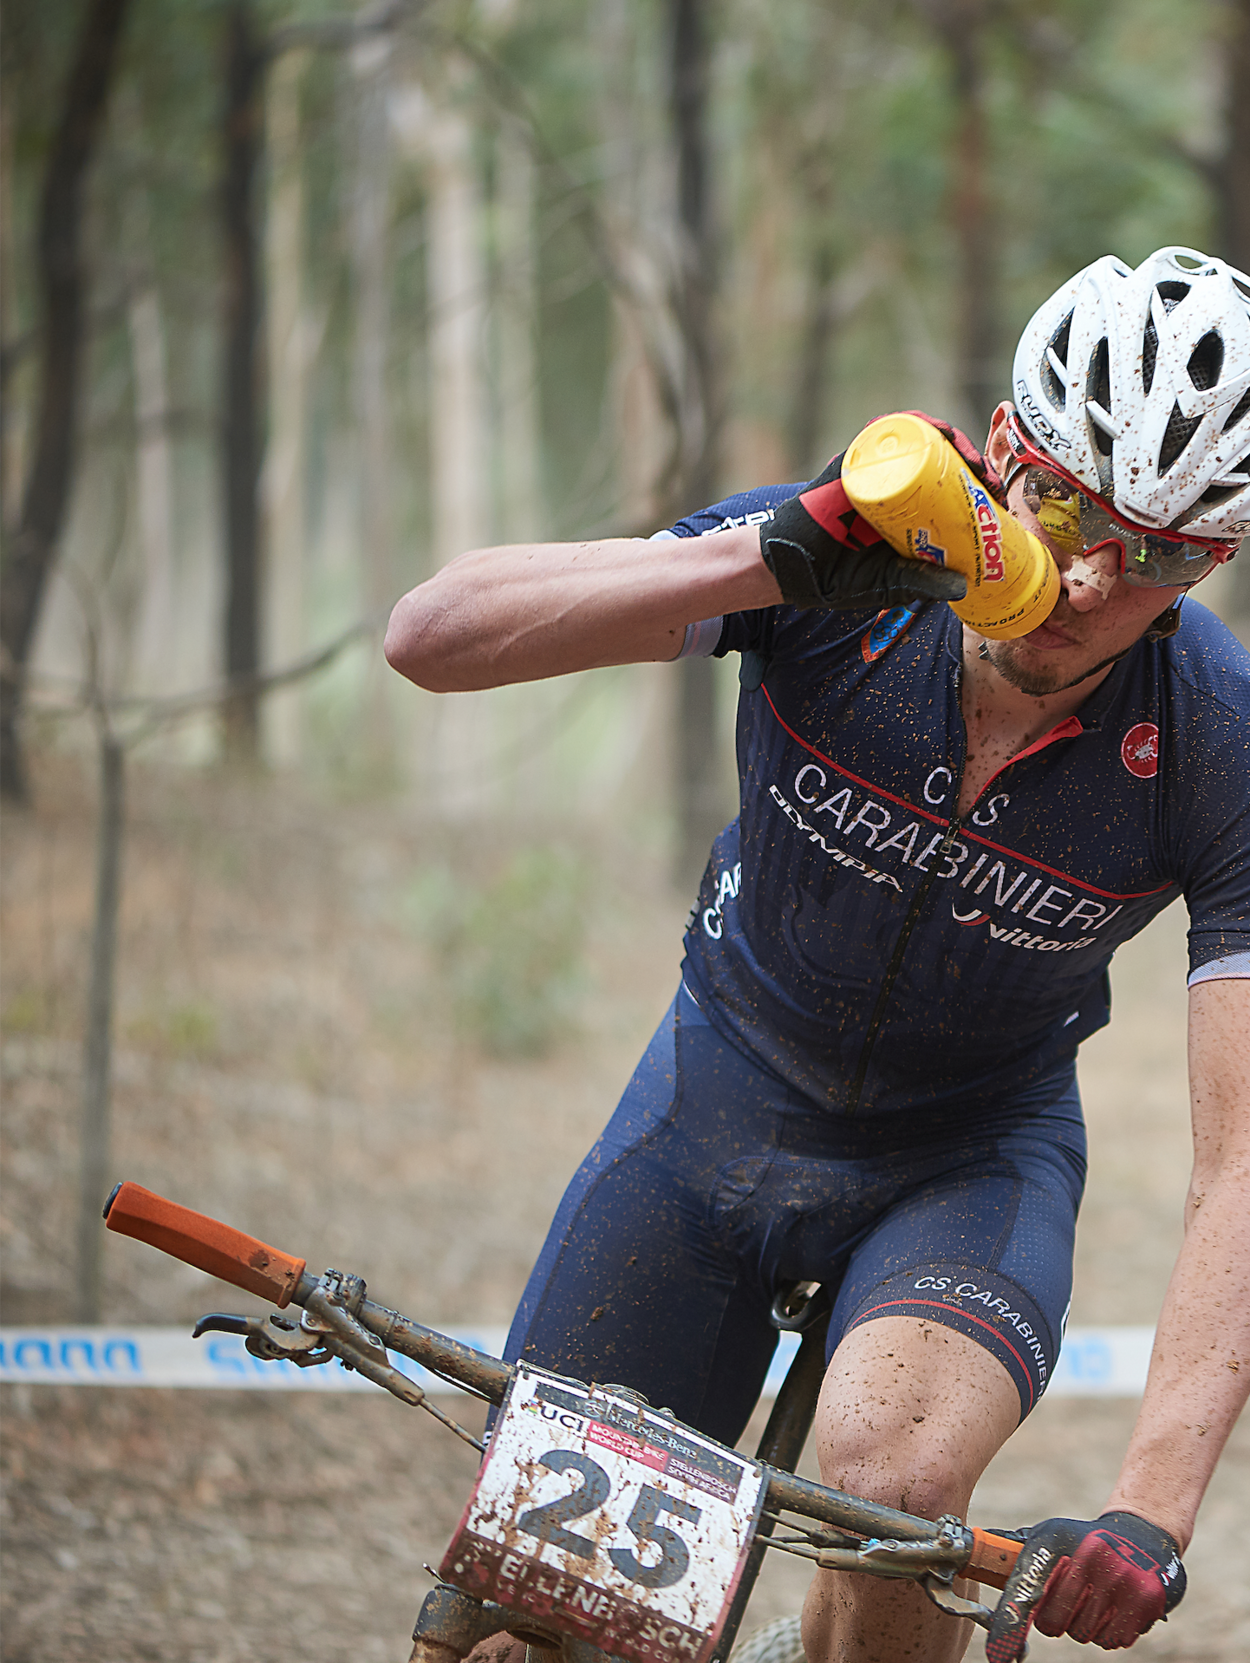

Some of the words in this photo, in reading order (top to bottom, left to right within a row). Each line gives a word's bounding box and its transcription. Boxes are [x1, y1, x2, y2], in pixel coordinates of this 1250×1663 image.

[769, 784, 903, 892] OLYMPIA
[794, 764, 1123, 931] CARABINIERI
[914, 1276, 951, 1290] CS
[540, 1405, 583, 1432] UCI
[624, 1445, 645, 1459] CUP
[518, 1449, 702, 1589] 25
